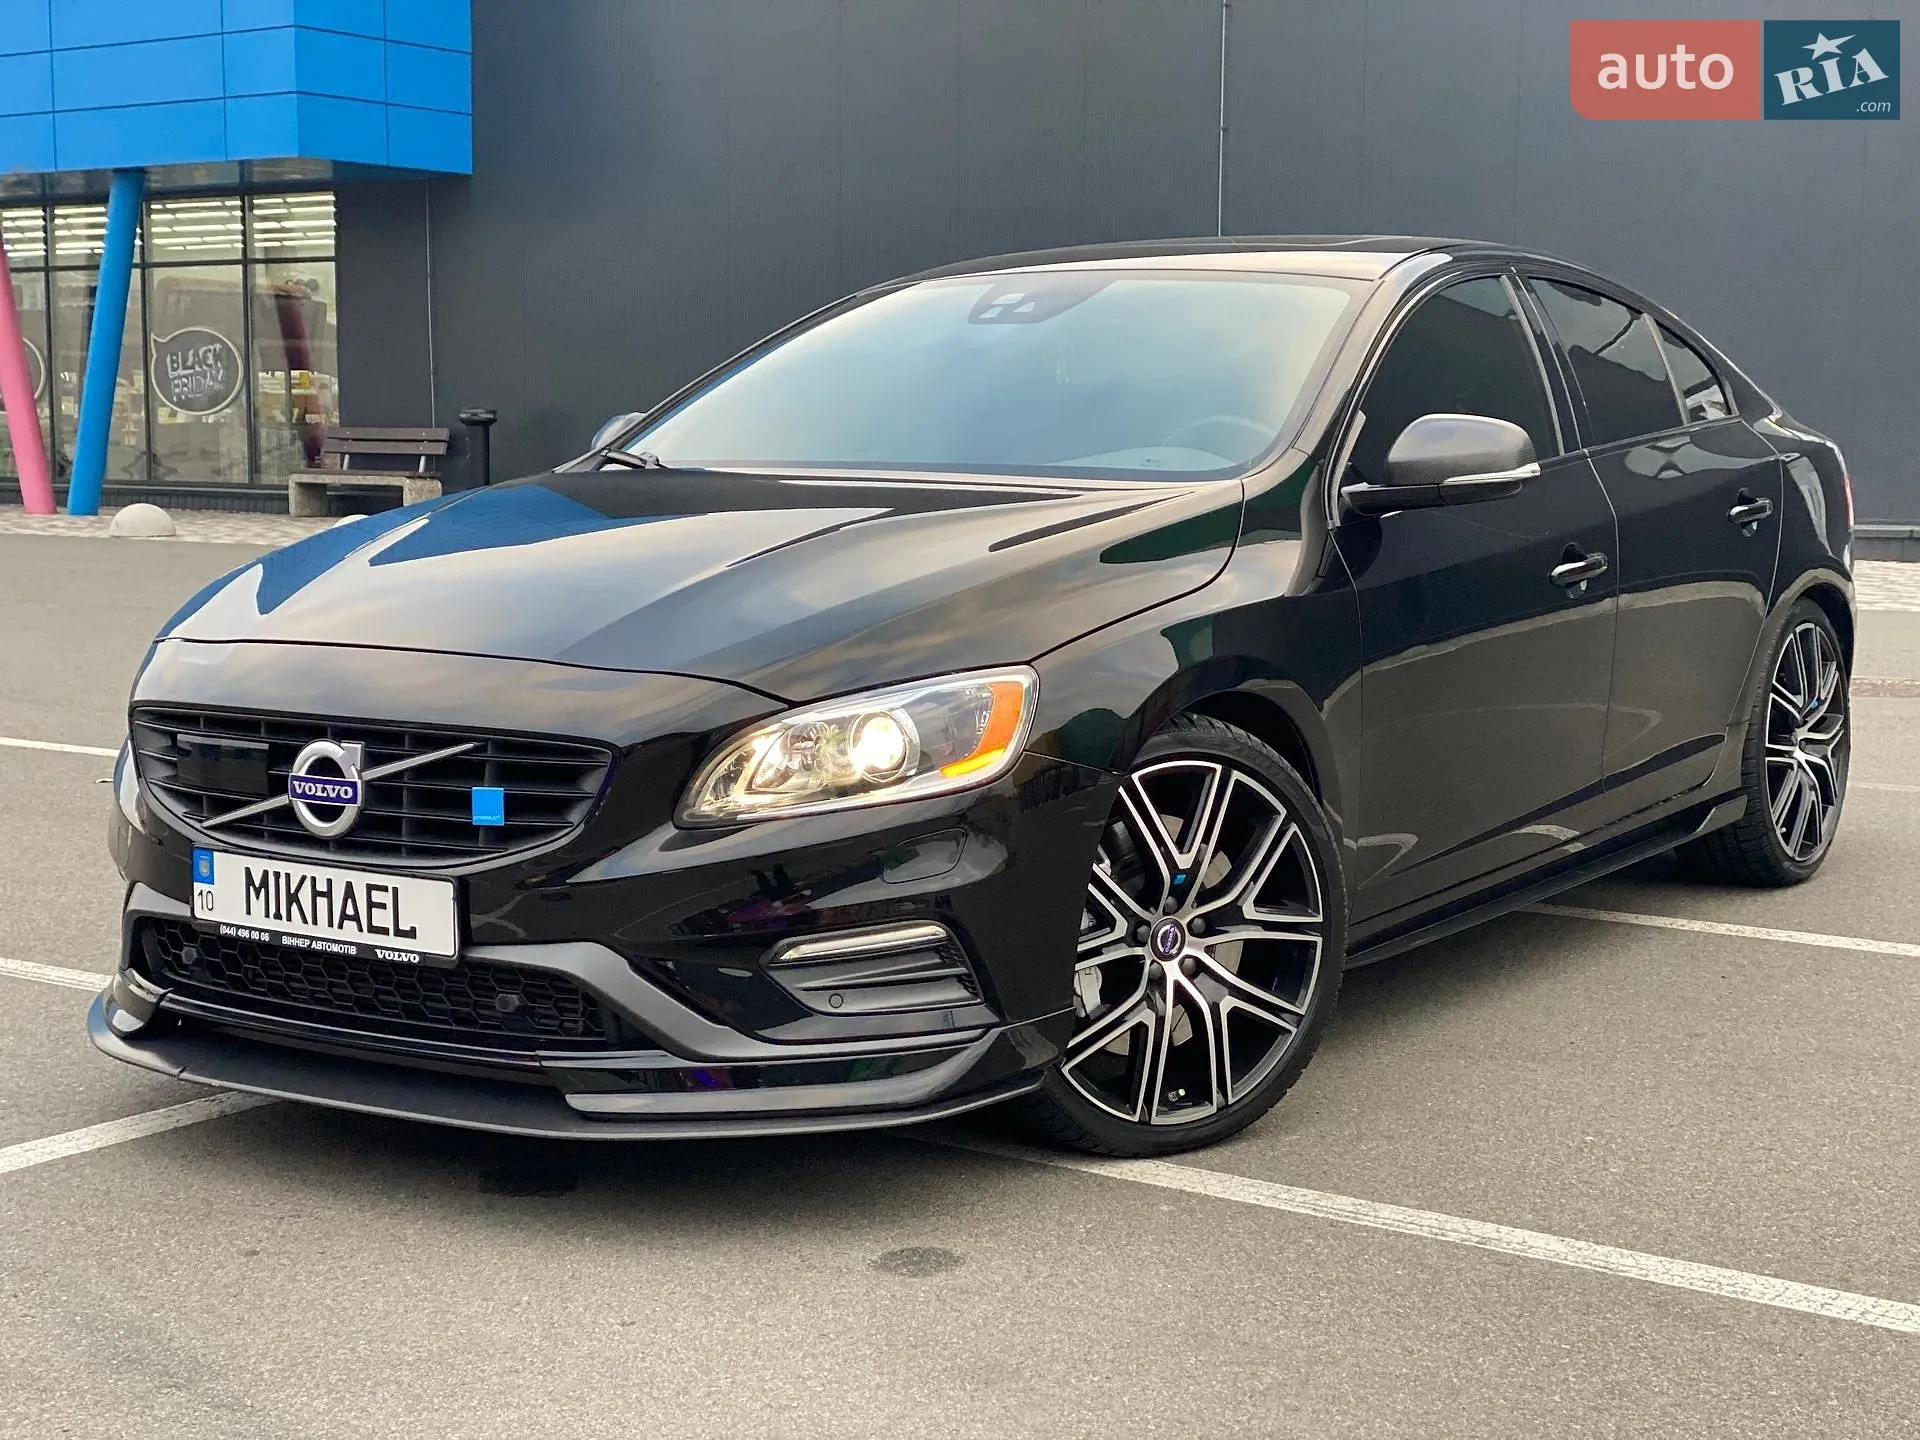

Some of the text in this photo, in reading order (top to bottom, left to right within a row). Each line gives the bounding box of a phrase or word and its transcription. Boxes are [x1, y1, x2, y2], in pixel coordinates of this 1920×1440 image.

[292, 781, 353, 799] VOLVO
[197, 889, 214, 912] 10
[244, 866, 417, 939] MIKHAEL
[219, 923, 236, 937] (044)
[250, 930, 260, 940] 00
[281, 936, 357, 955] ВІННЕР АВТОМОТІВ
[375, 949, 419, 963] VOLVO
